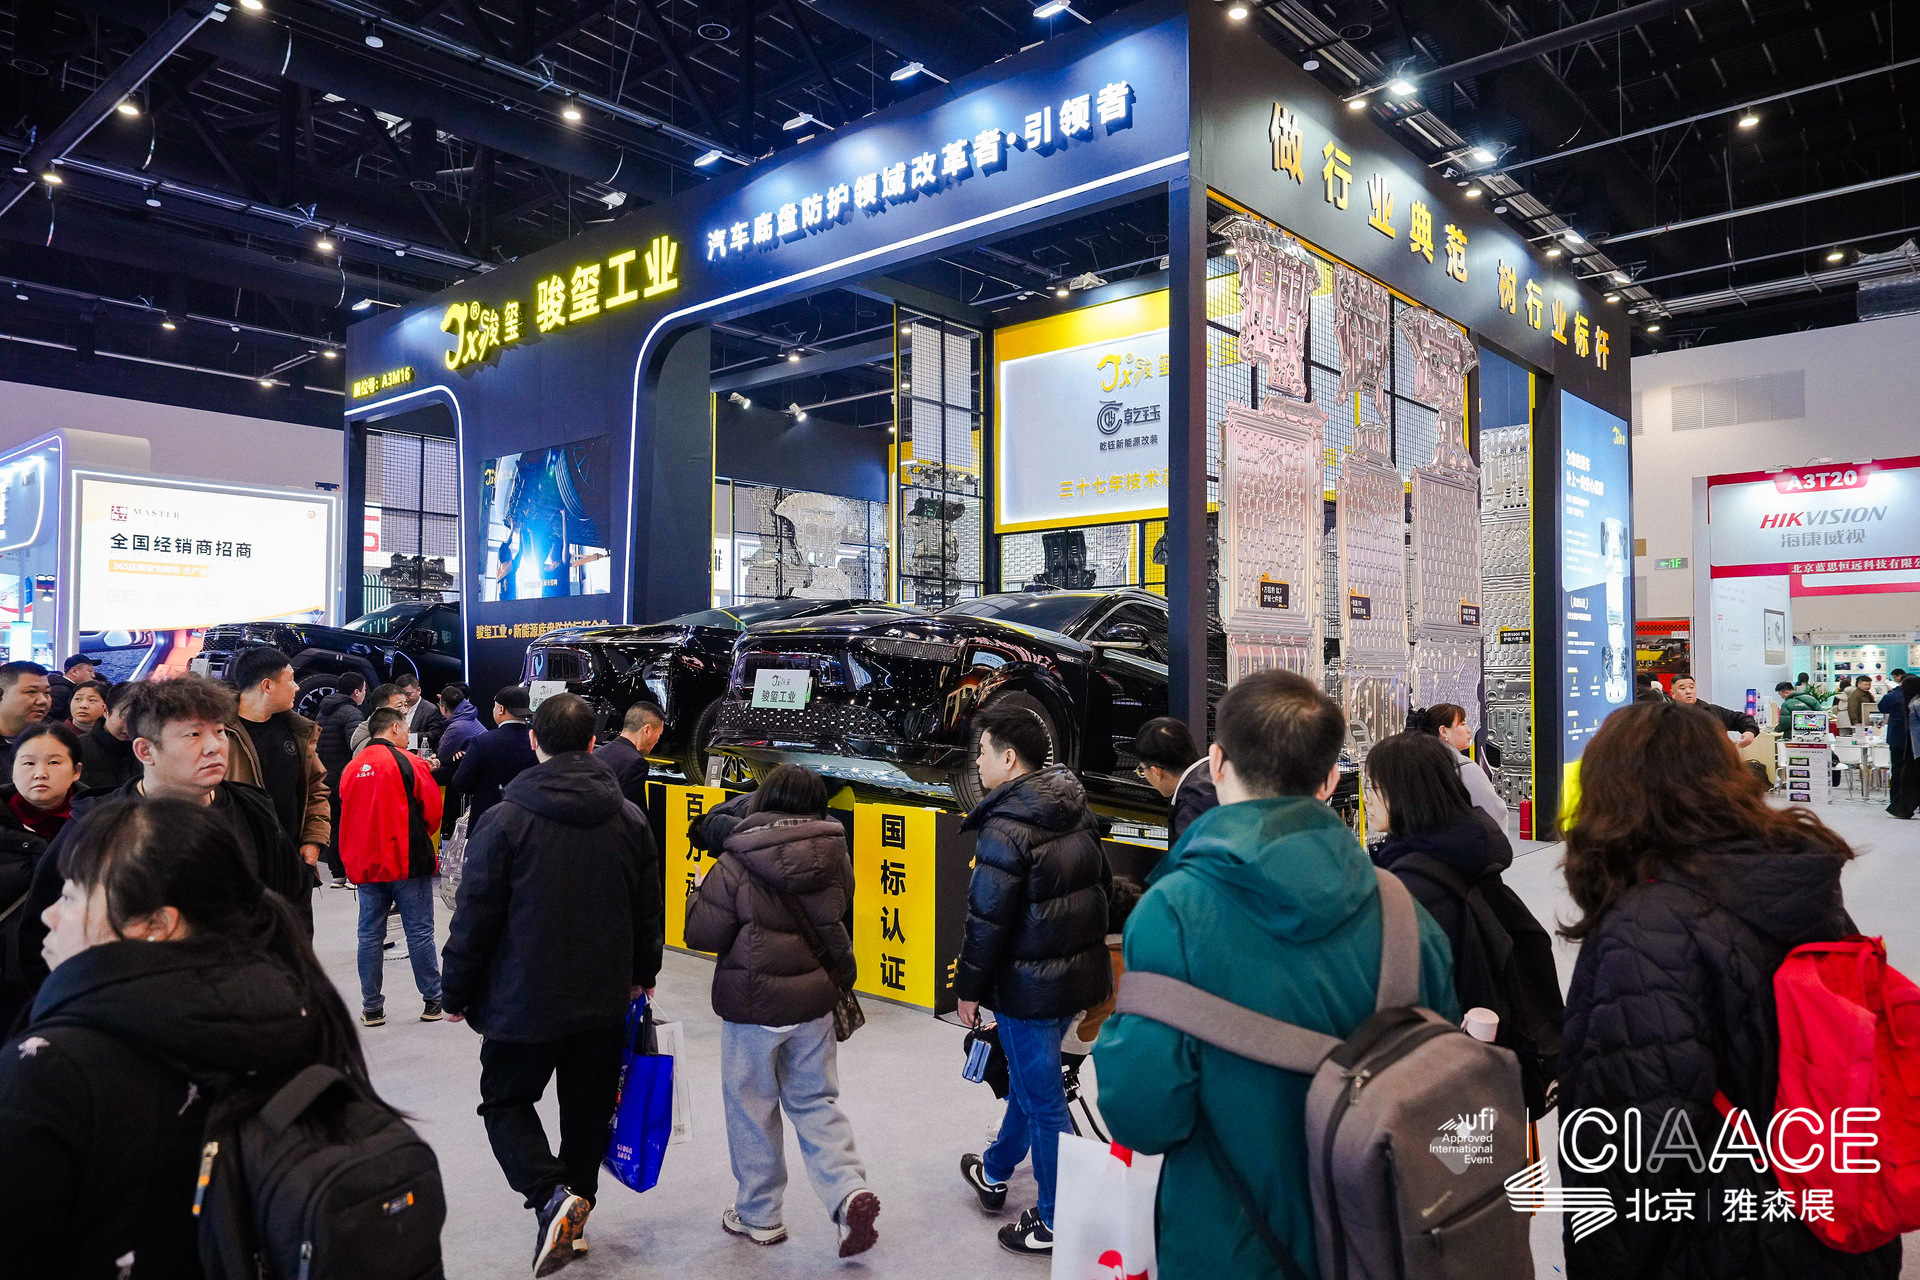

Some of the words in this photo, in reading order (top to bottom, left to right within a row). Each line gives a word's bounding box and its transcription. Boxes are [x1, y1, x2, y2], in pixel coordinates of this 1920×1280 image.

[1269, 101, 1469, 284] 做行业典范
[1497, 258, 1610, 370] 树行业标杆
[536, 234, 679, 333] 骏玺工业
[1786, 470, 1858, 491] A3T20
[133, 508, 180, 519] MASTER
[1759, 505, 1888, 529] HIKVISION
[110, 533, 252, 559] 全国经销商招商
[1781, 528, 1866, 548] 海康威视
[761, 690, 796, 703] 骏玺工业
[880, 813, 906, 991] 国标认证
